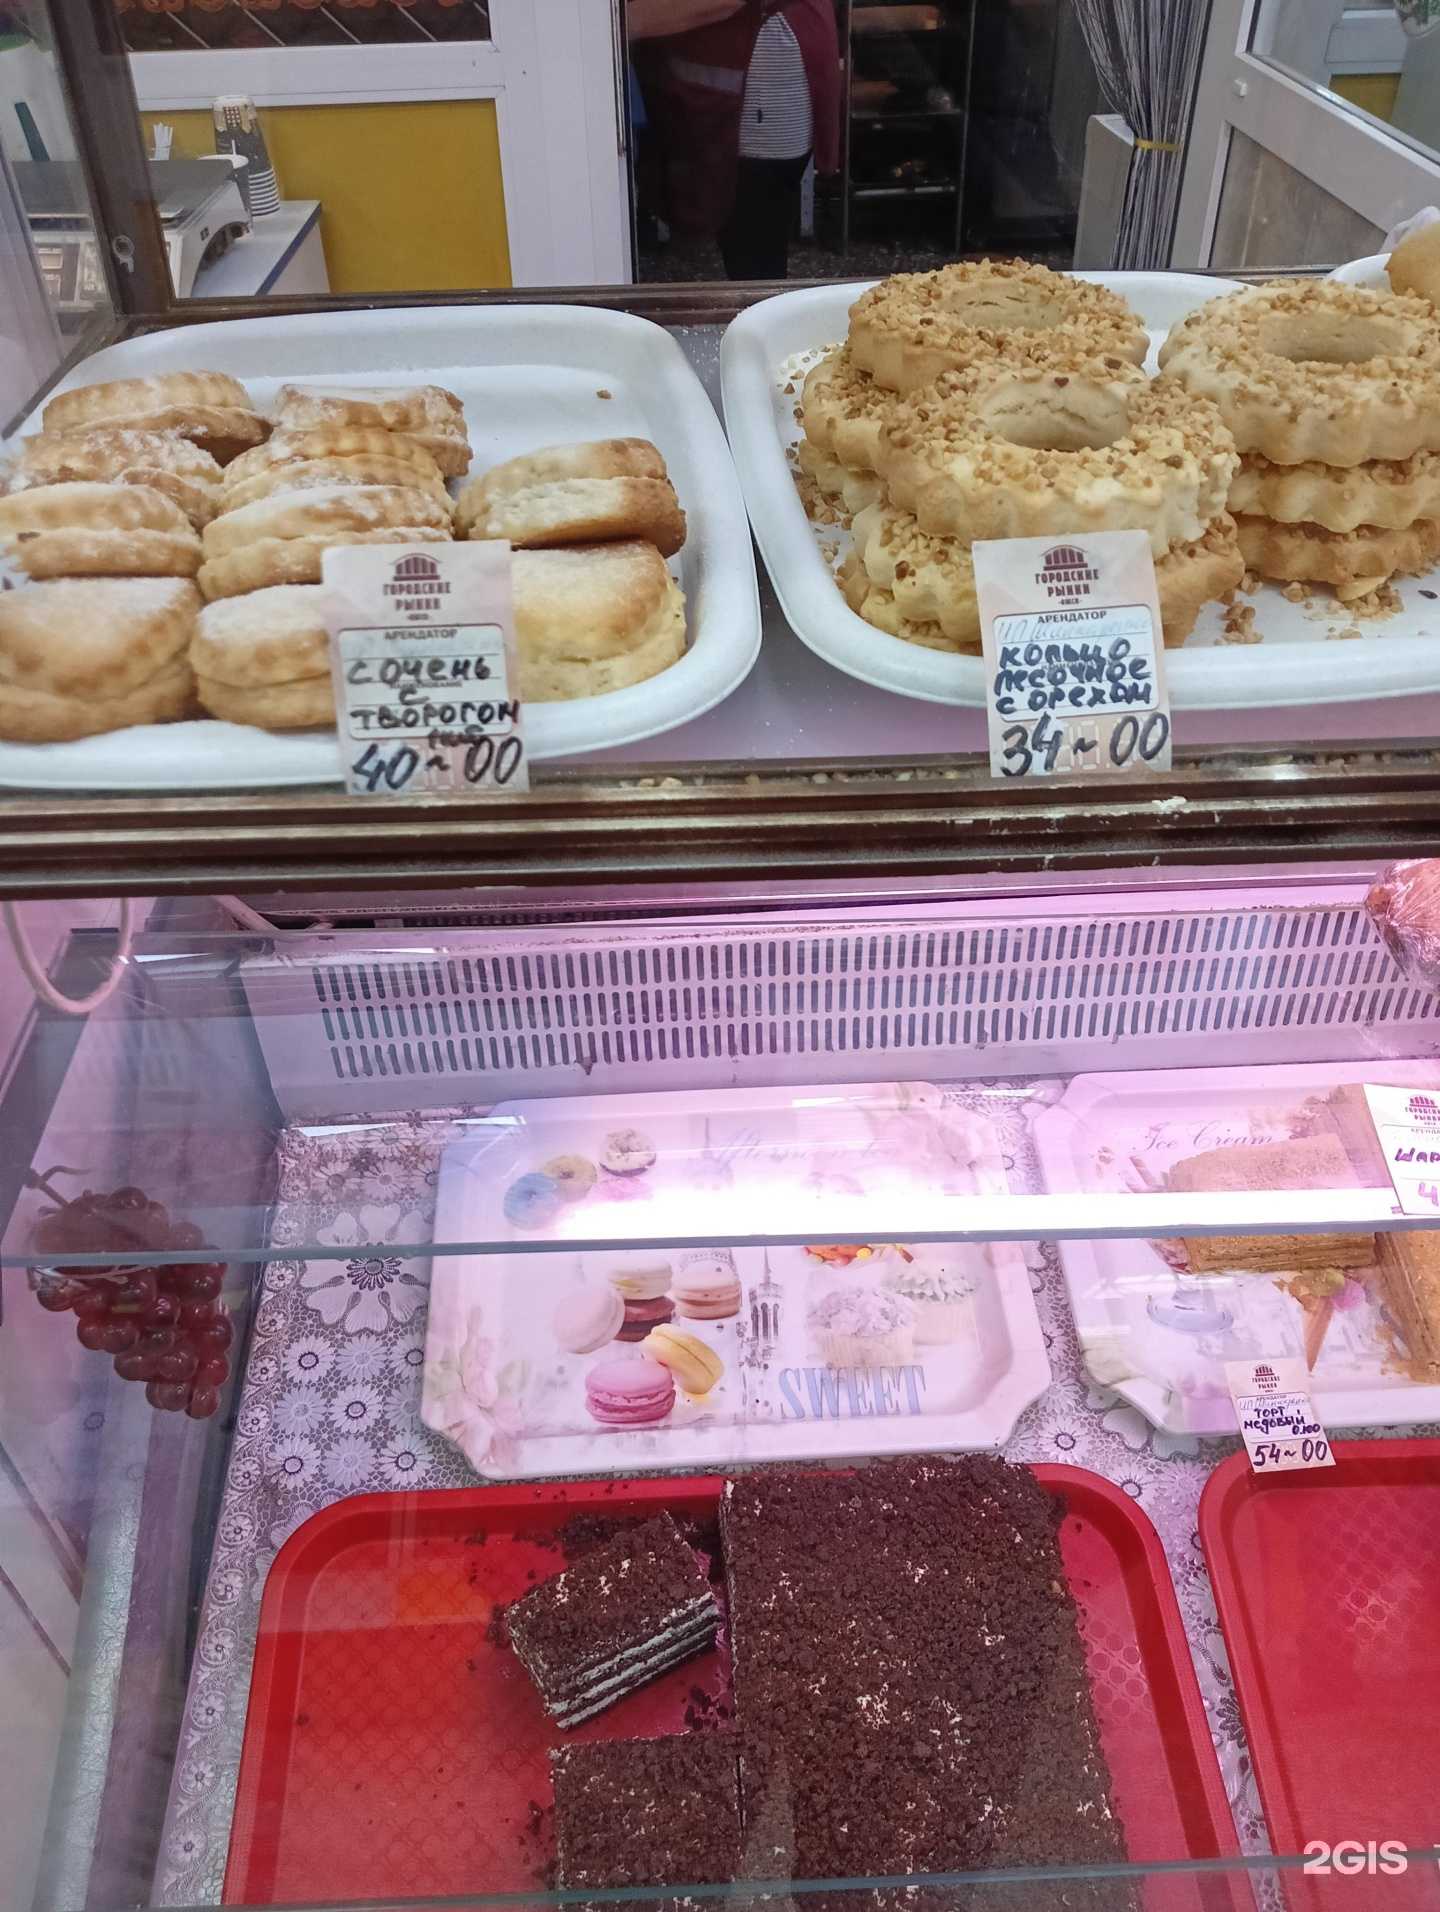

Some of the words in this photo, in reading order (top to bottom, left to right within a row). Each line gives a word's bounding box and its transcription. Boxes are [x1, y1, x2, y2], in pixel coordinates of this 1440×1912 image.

[1035, 569, 1100, 584] ГОРОДСКИЕ
[1047, 584, 1090, 597] РЫНКИ
[1038, 611, 1107, 623] АРЕНДАТОР
[384, 629, 458, 640] АРЕНДАТОР
[778, 1365, 927, 1420] SWEET
